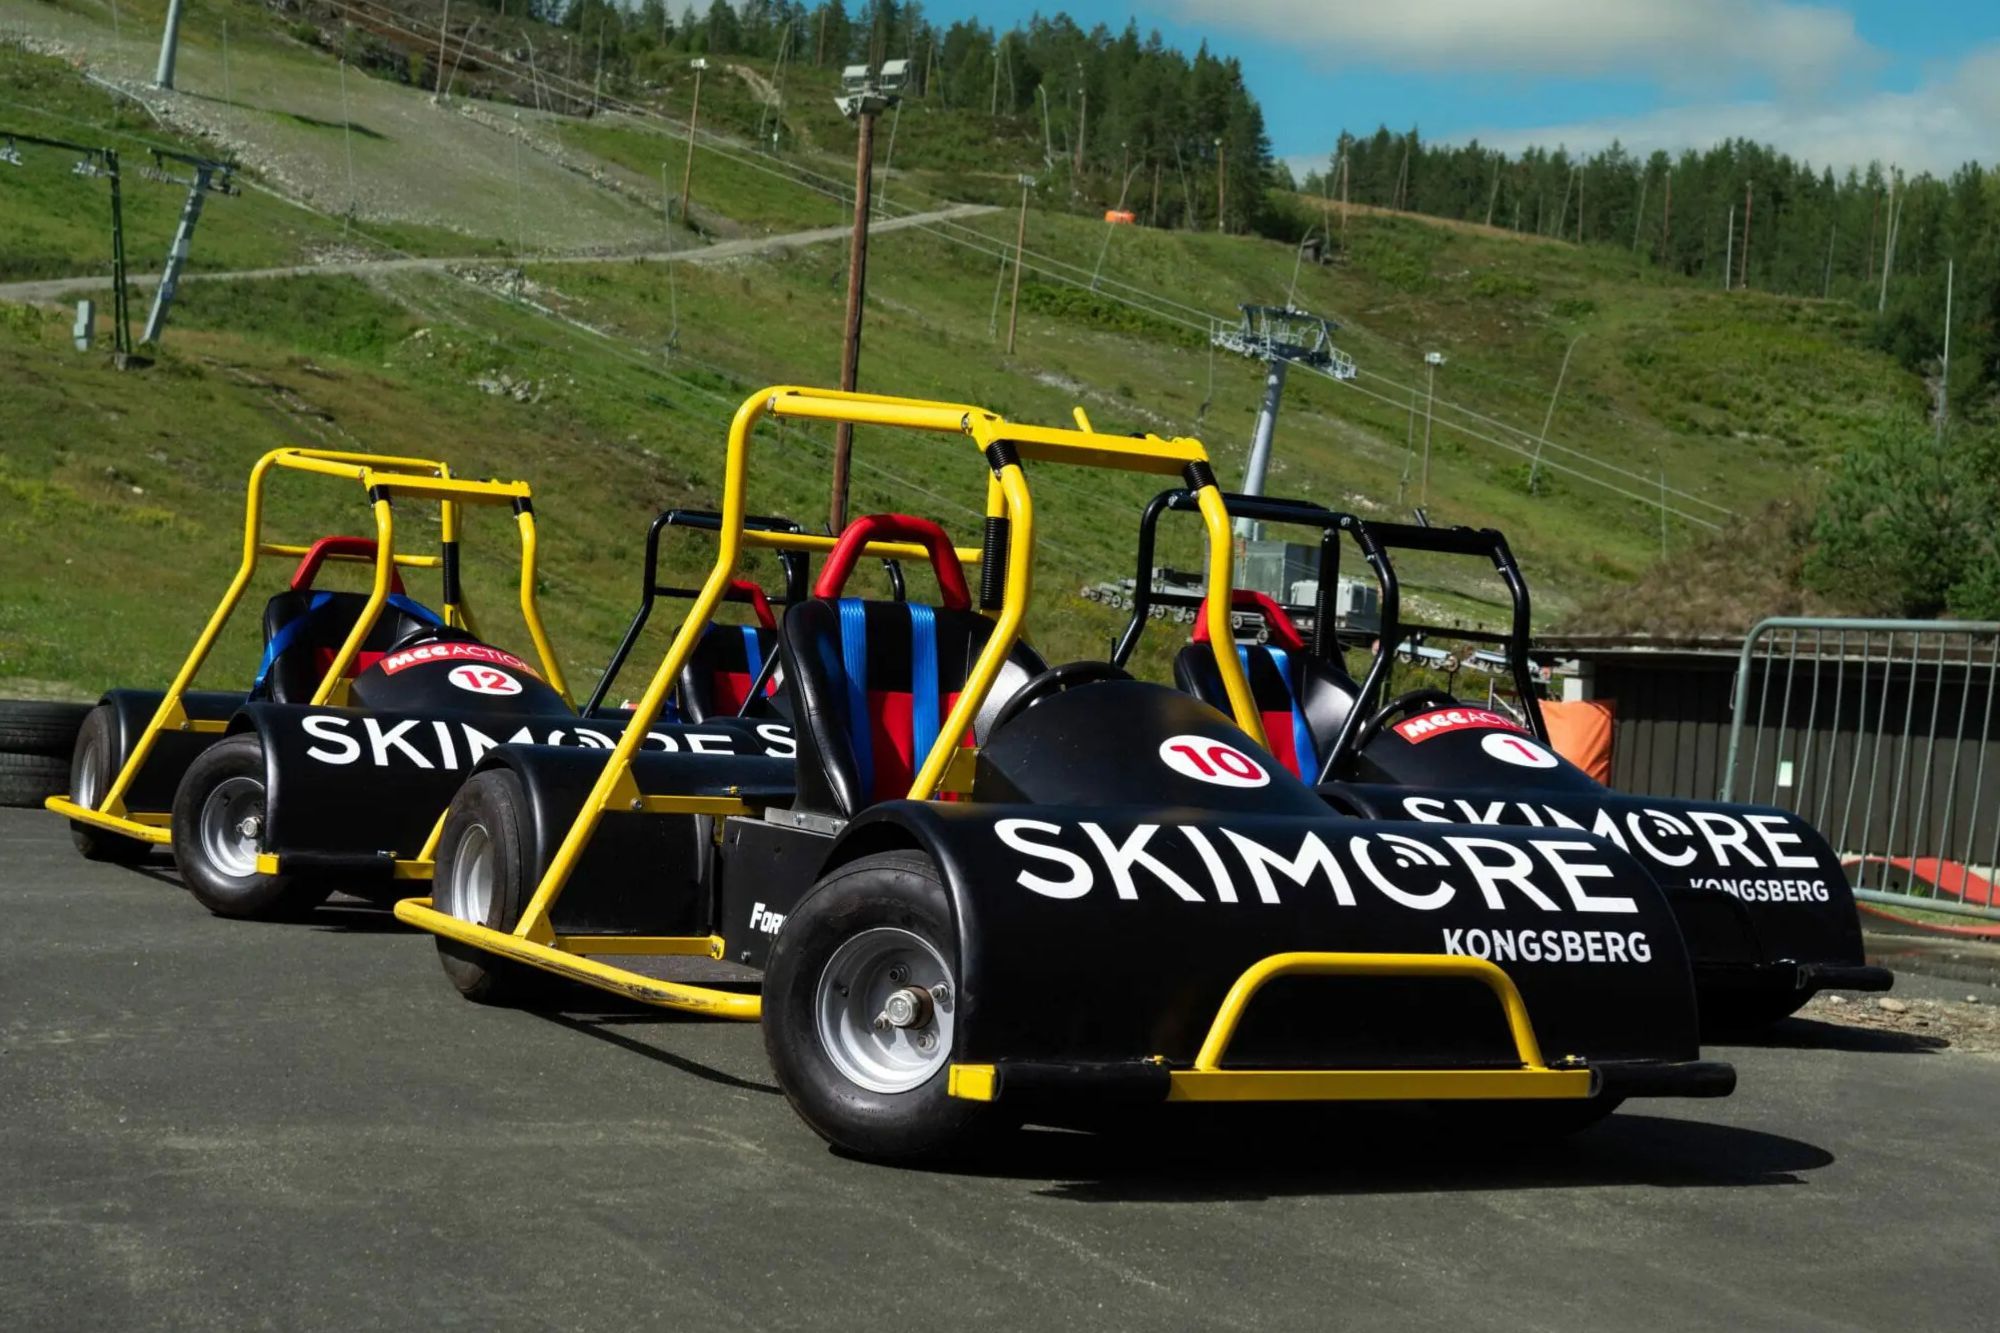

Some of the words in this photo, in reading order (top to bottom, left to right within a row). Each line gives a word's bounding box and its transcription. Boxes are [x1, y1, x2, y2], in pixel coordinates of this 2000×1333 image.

[460, 669, 512, 691] 12
[1171, 744, 1263, 781] 10
[1504, 739, 1537, 762] 1
[994, 818, 1639, 913] SKIMORE
[1442, 928, 1652, 963] KONGSBERG
